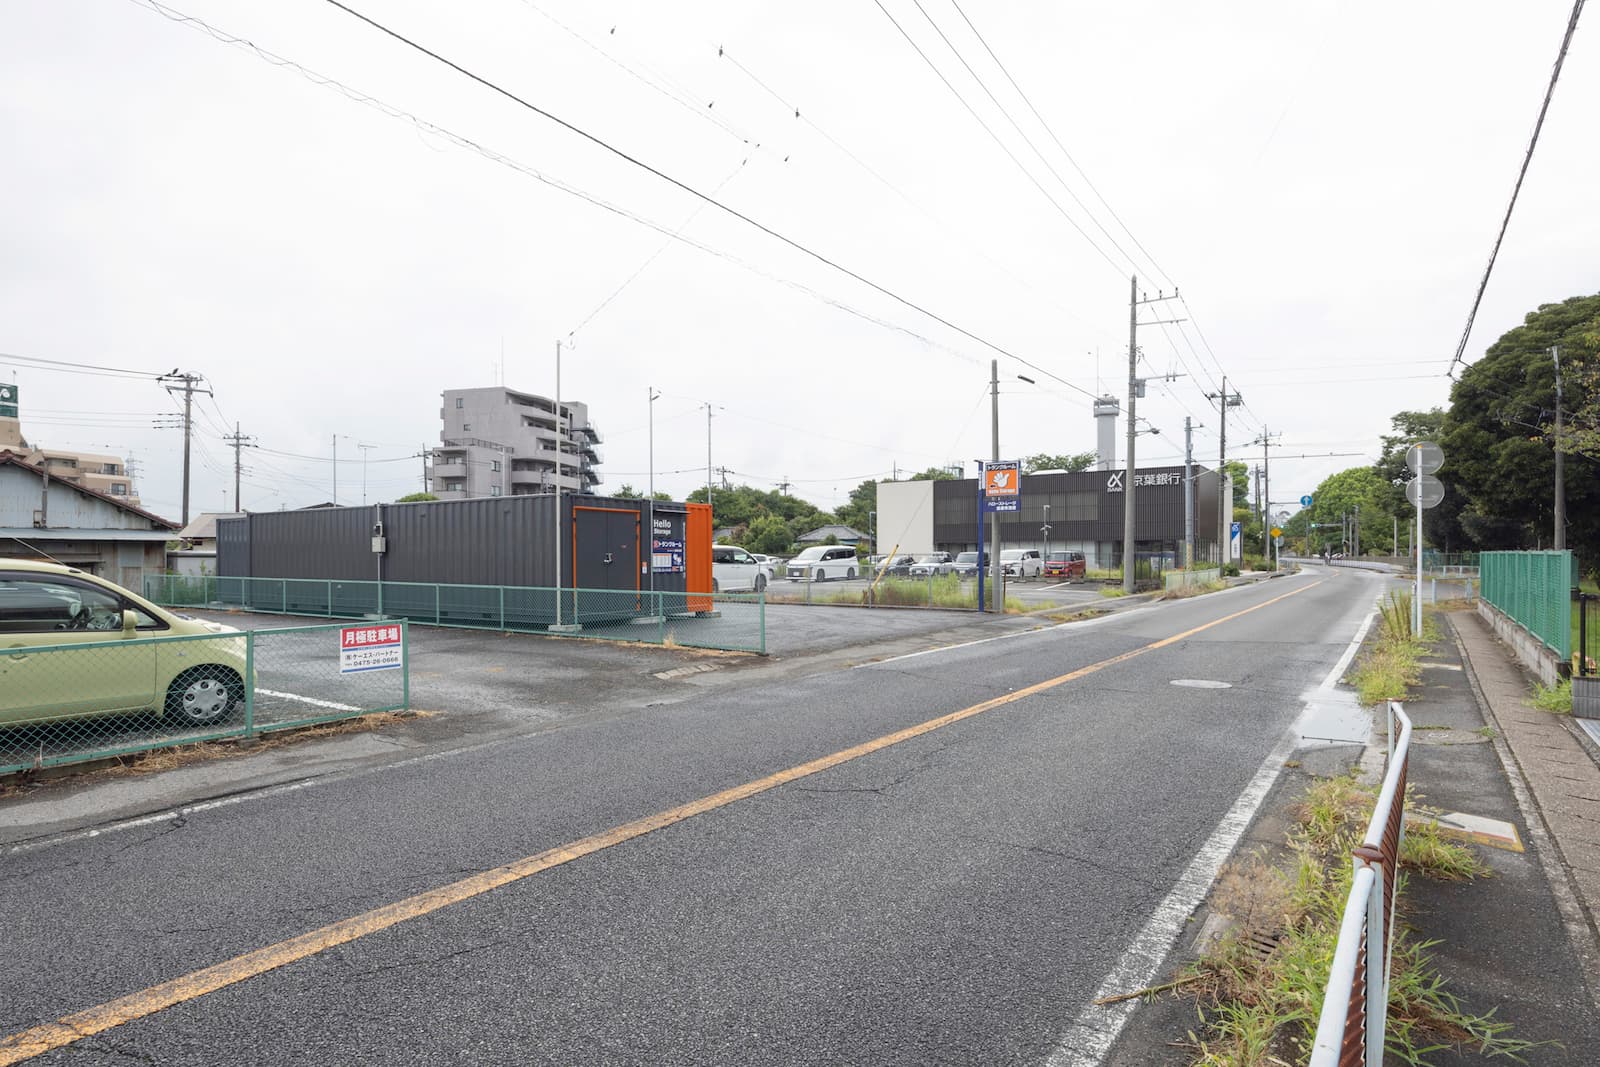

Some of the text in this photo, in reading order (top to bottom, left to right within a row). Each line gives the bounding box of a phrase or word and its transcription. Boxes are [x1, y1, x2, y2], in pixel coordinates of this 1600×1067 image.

[1134, 473, 1181, 486] 京葉銀行
[653, 519, 671, 529] Hello
[653, 528, 671, 536] Storage
[345, 627, 398, 645] 月極駐車場
